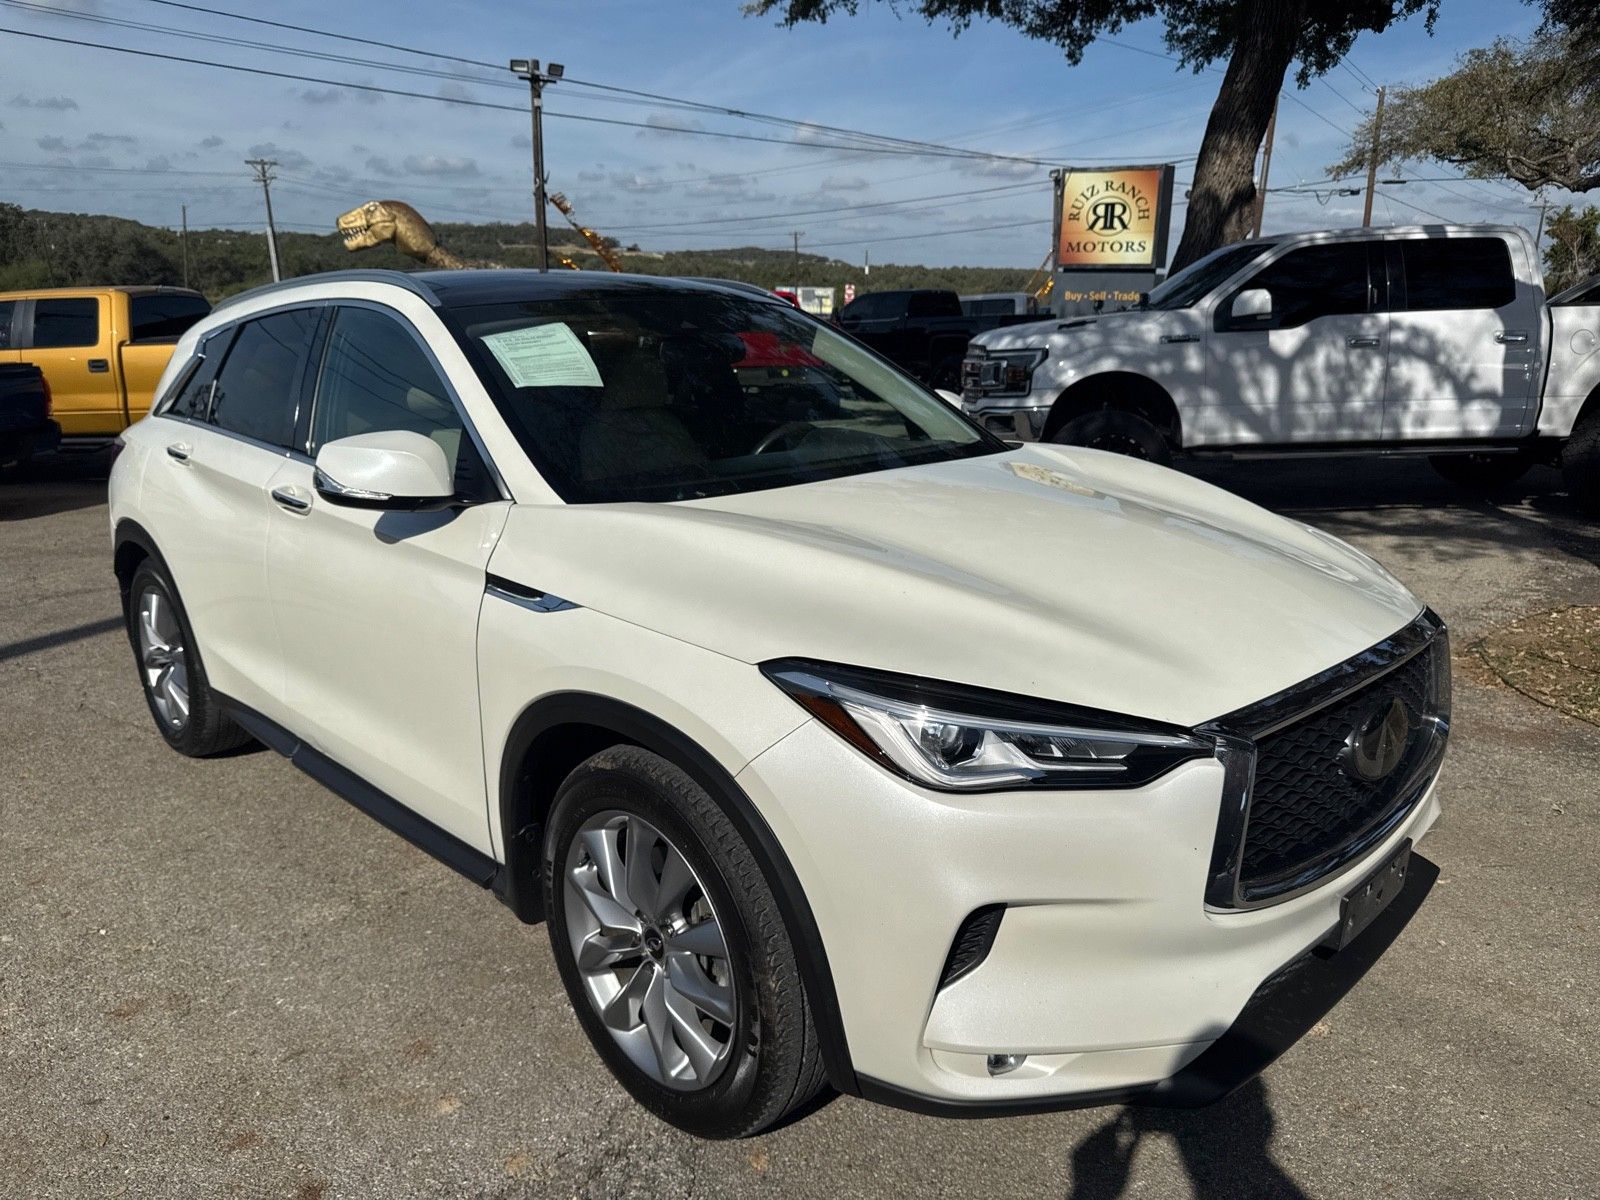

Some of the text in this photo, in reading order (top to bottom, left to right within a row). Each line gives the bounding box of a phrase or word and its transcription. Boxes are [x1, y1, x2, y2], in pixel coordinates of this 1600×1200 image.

[1068, 180, 1150, 221] RUIZ RANCH
[1066, 240, 1147, 253] MOTORS
[1065, 291, 1141, 301] Buy Sell Trade
